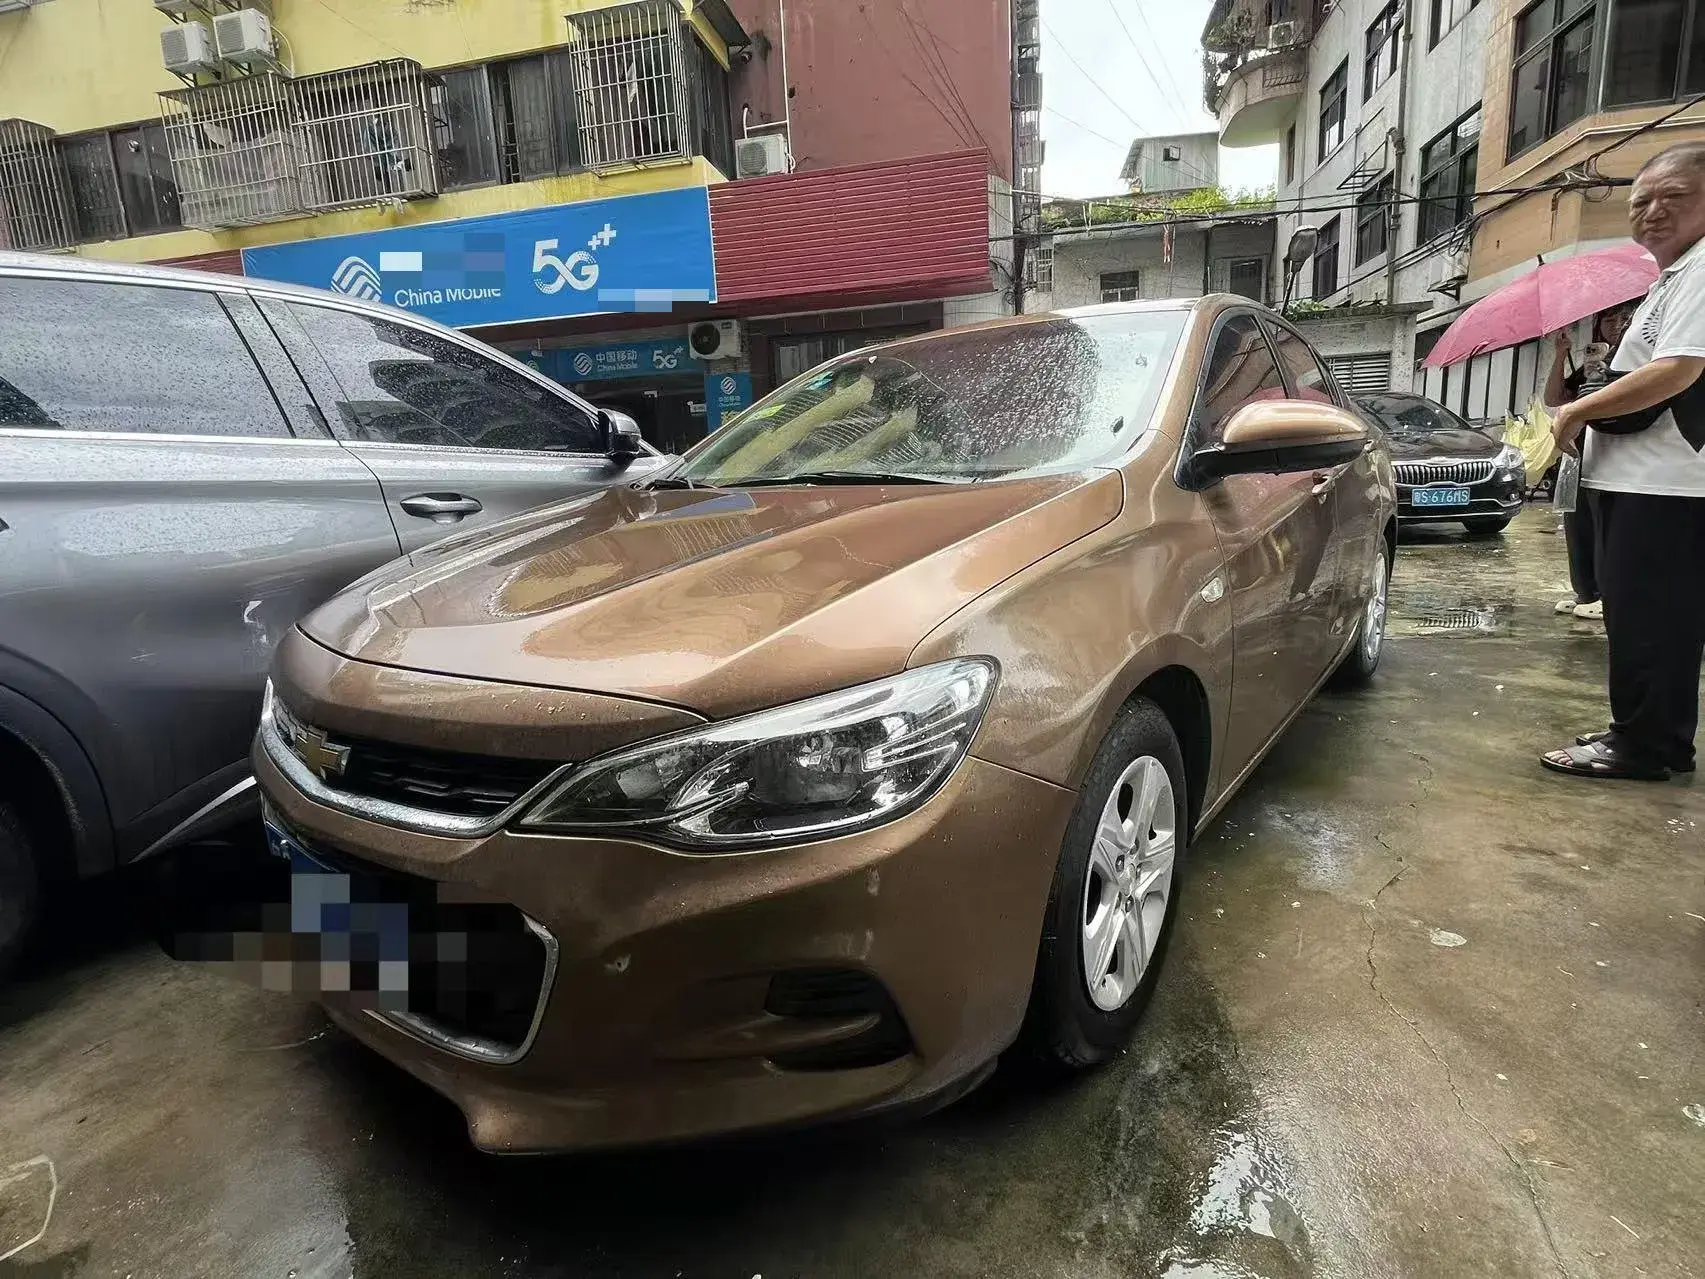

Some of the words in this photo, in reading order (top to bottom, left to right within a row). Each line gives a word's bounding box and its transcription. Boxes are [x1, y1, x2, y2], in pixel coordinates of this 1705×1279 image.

[394, 289, 442, 307] China
[595, 349, 638, 363] 中国移动
